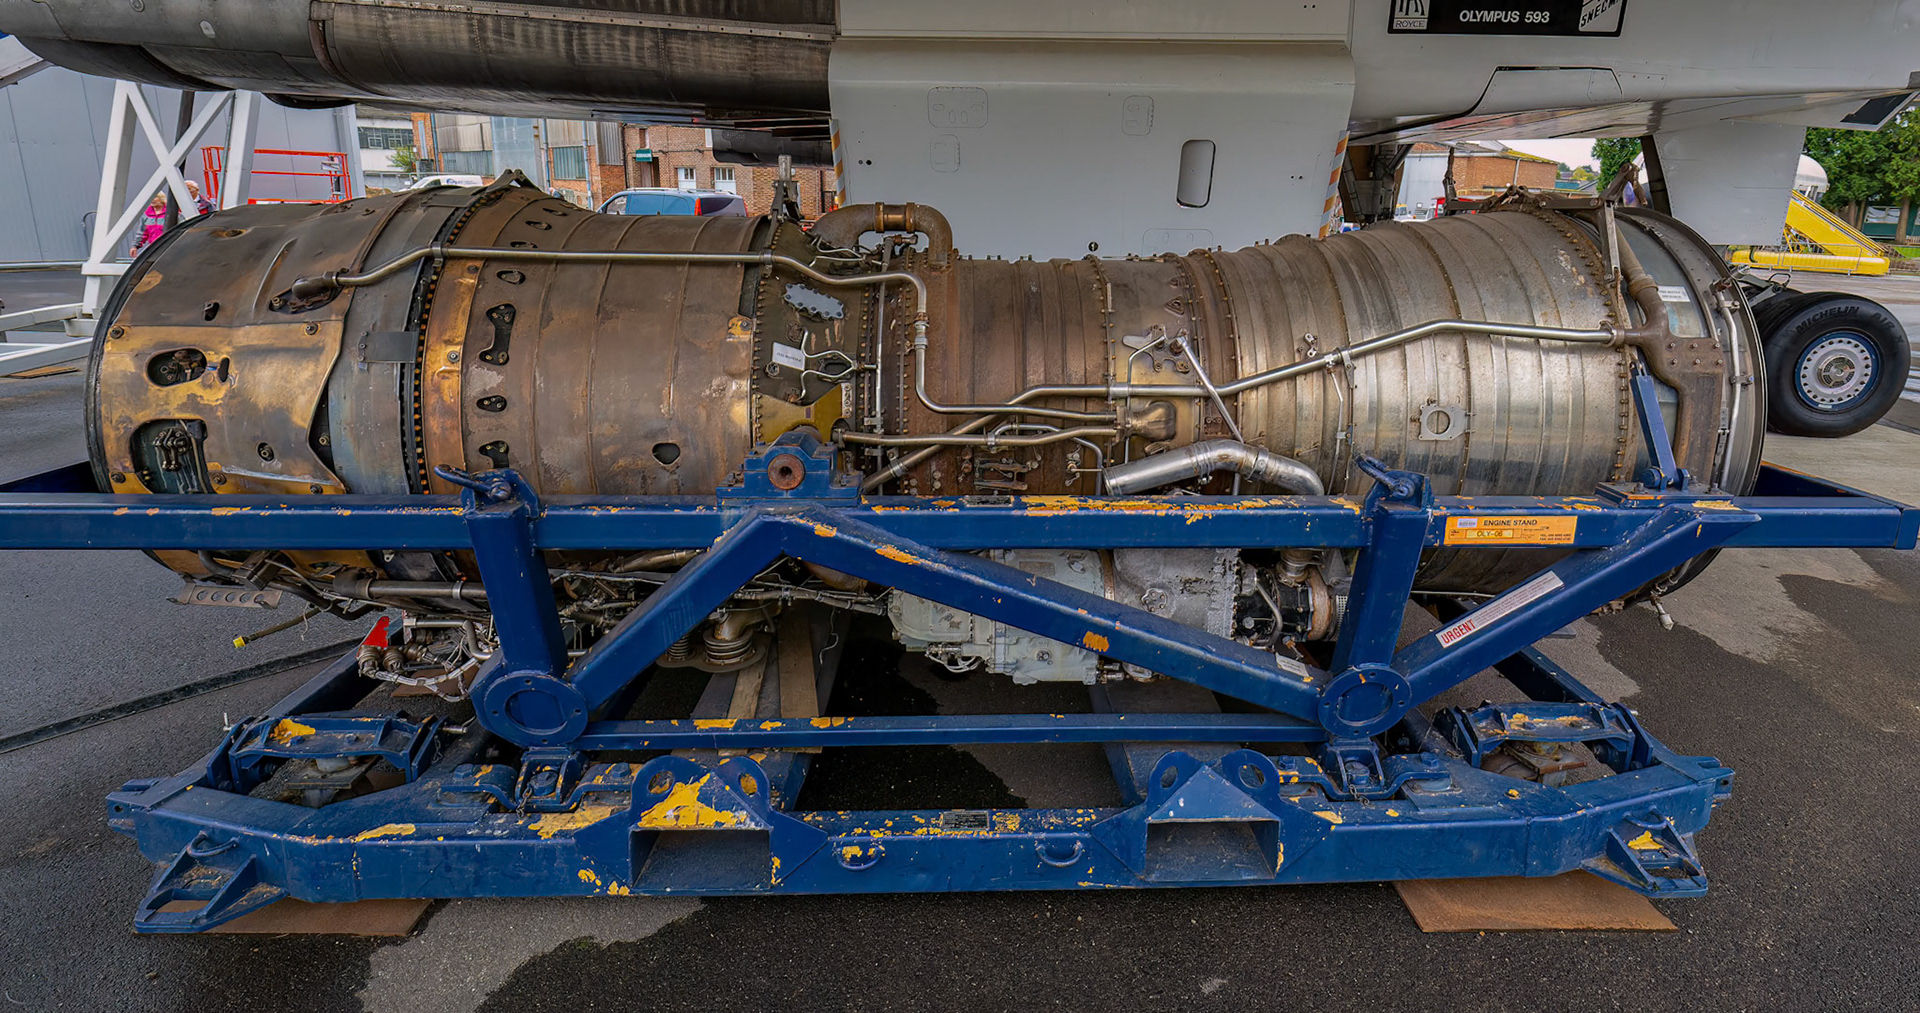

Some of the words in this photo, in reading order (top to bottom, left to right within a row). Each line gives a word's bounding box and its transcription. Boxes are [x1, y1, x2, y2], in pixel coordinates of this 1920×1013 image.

[1395, 20, 1426, 28] ROYCE
[1459, 10, 1520, 23] OLYMPUS
[1524, 11, 1550, 23] 593
[1795, 306, 1860, 333] MICHELIN
[1870, 312, 1896, 330] AIR
[1441, 619, 1476, 644] URGENT
